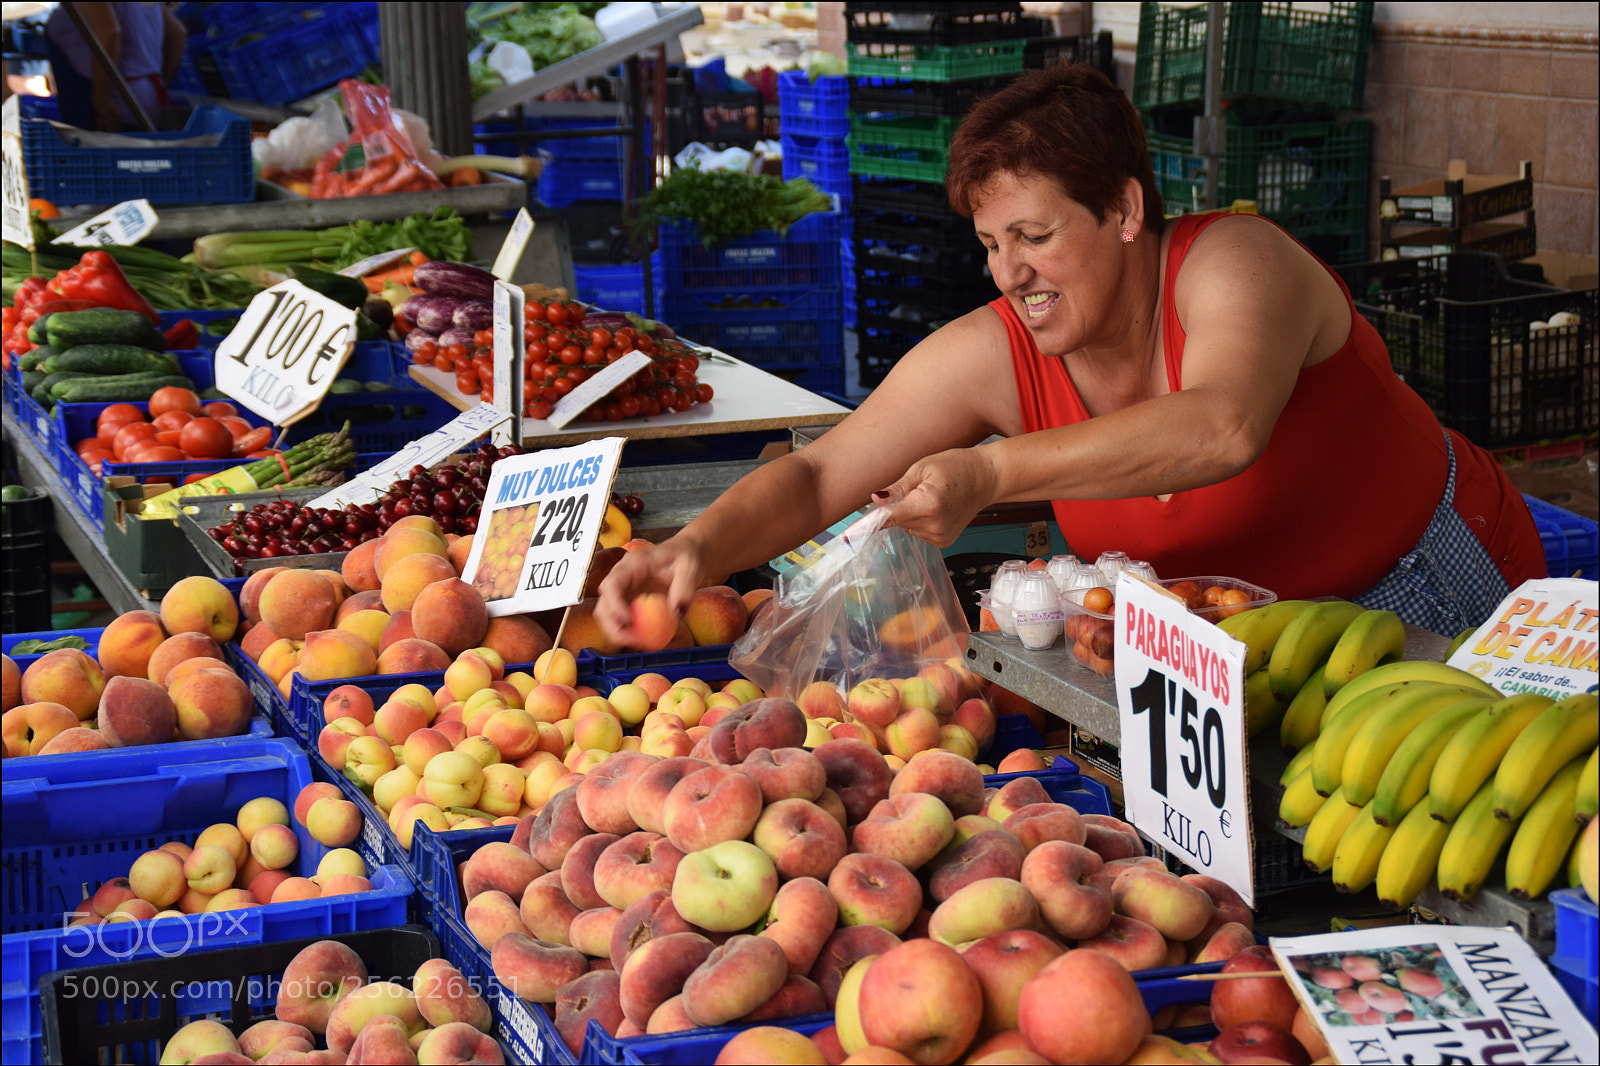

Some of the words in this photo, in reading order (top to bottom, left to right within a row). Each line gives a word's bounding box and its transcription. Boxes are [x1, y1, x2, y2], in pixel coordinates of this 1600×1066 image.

[307, 323, 351, 386] €
[241, 365, 295, 411] KILO
[495, 468, 540, 504] MUY
[534, 454, 604, 497] DULCES
[529, 493, 589, 548] 2'20
[1027, 531, 1048, 549] 35
[525, 558, 570, 591] KILO
[1126, 601, 1230, 706] PARAGUAYOS
[1471, 621, 1534, 660] DE
[1501, 680, 1571, 701] CANARIAS
[1518, 671, 1554, 684] sabor
[1130, 667, 1226, 810] 1'50
[1161, 800, 1212, 868] KILO
[1454, 941, 1583, 1065] MANZAN
